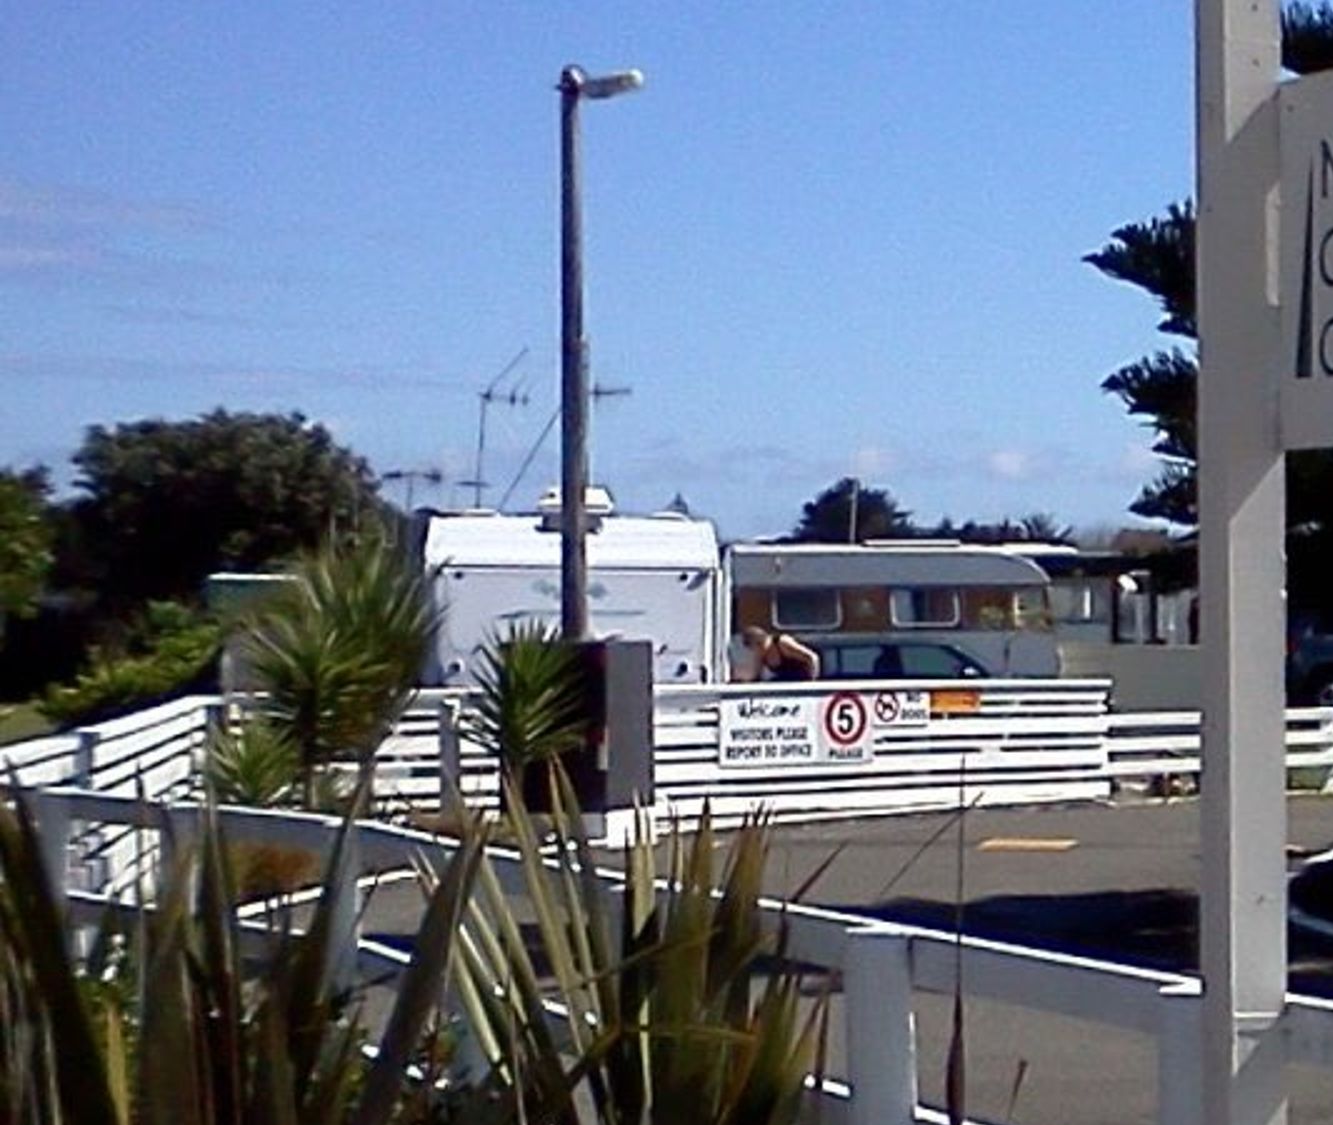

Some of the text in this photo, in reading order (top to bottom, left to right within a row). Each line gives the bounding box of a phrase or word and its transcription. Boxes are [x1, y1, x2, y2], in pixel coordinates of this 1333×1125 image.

[837, 703, 853, 735] 5
[730, 726, 807, 741] VISITORS PLEASE
[726, 744, 812, 760] REPORT TO OFFICE
[829, 748, 863, 759] PLEASE
